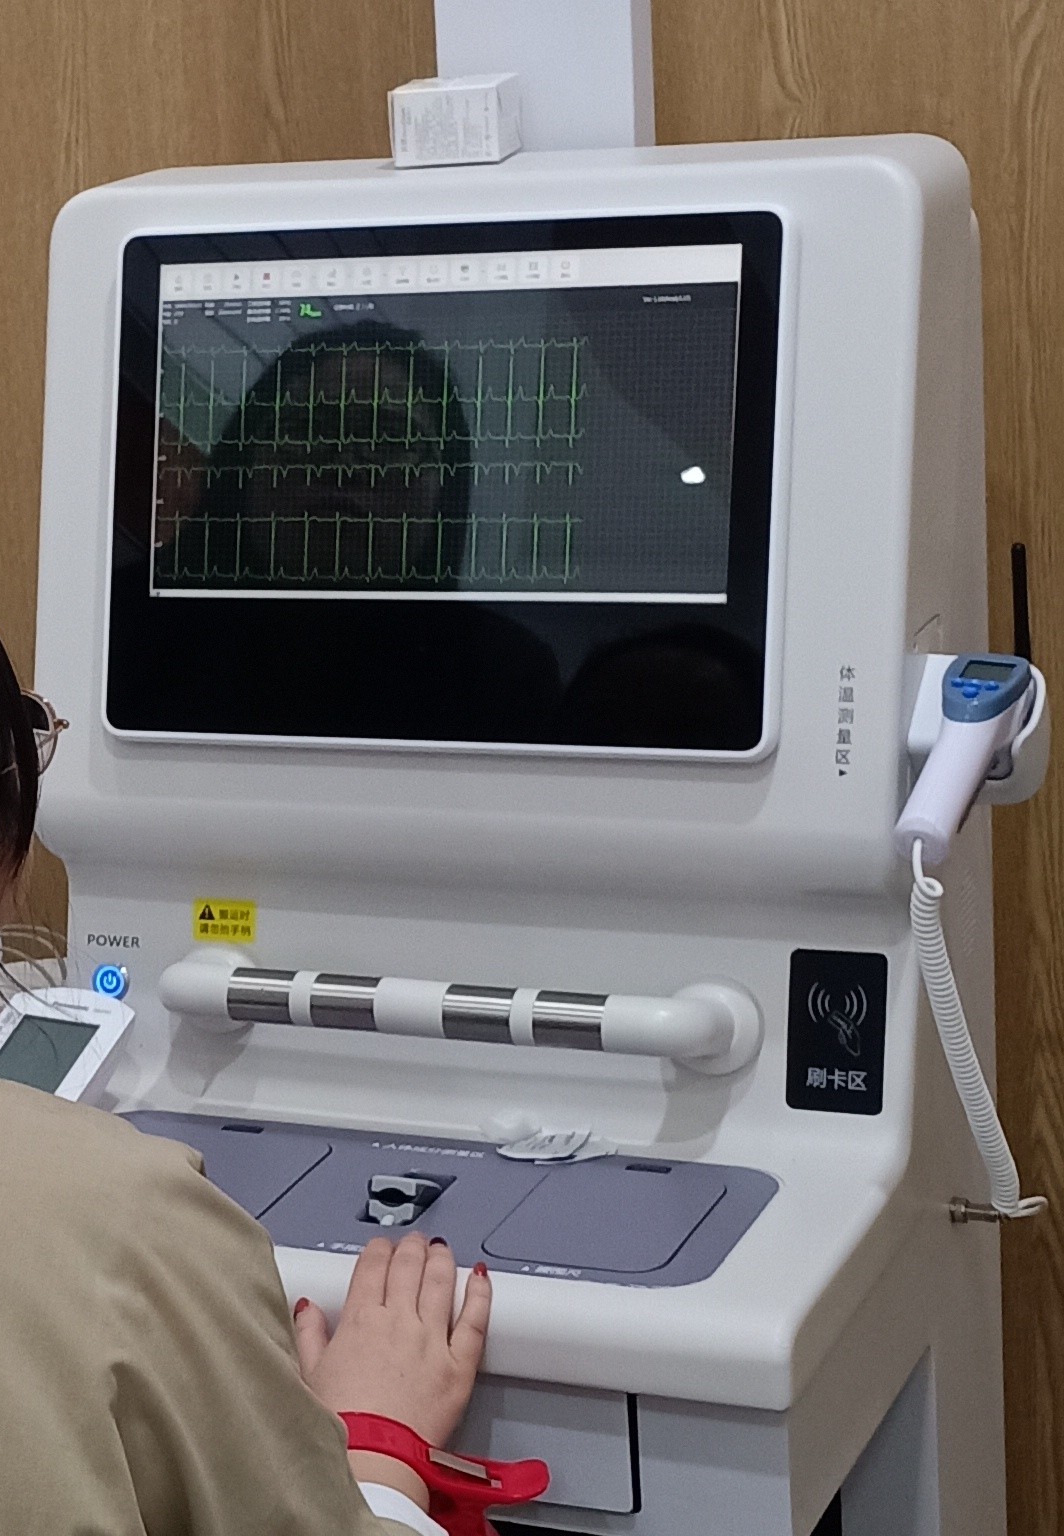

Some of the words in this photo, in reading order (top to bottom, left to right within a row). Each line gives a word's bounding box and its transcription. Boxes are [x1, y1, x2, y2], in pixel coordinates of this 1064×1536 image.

[835, 665, 856, 765] 体温测量区
[87, 933, 141, 949] POWER
[806, 1067, 867, 1092] 刷卡区
